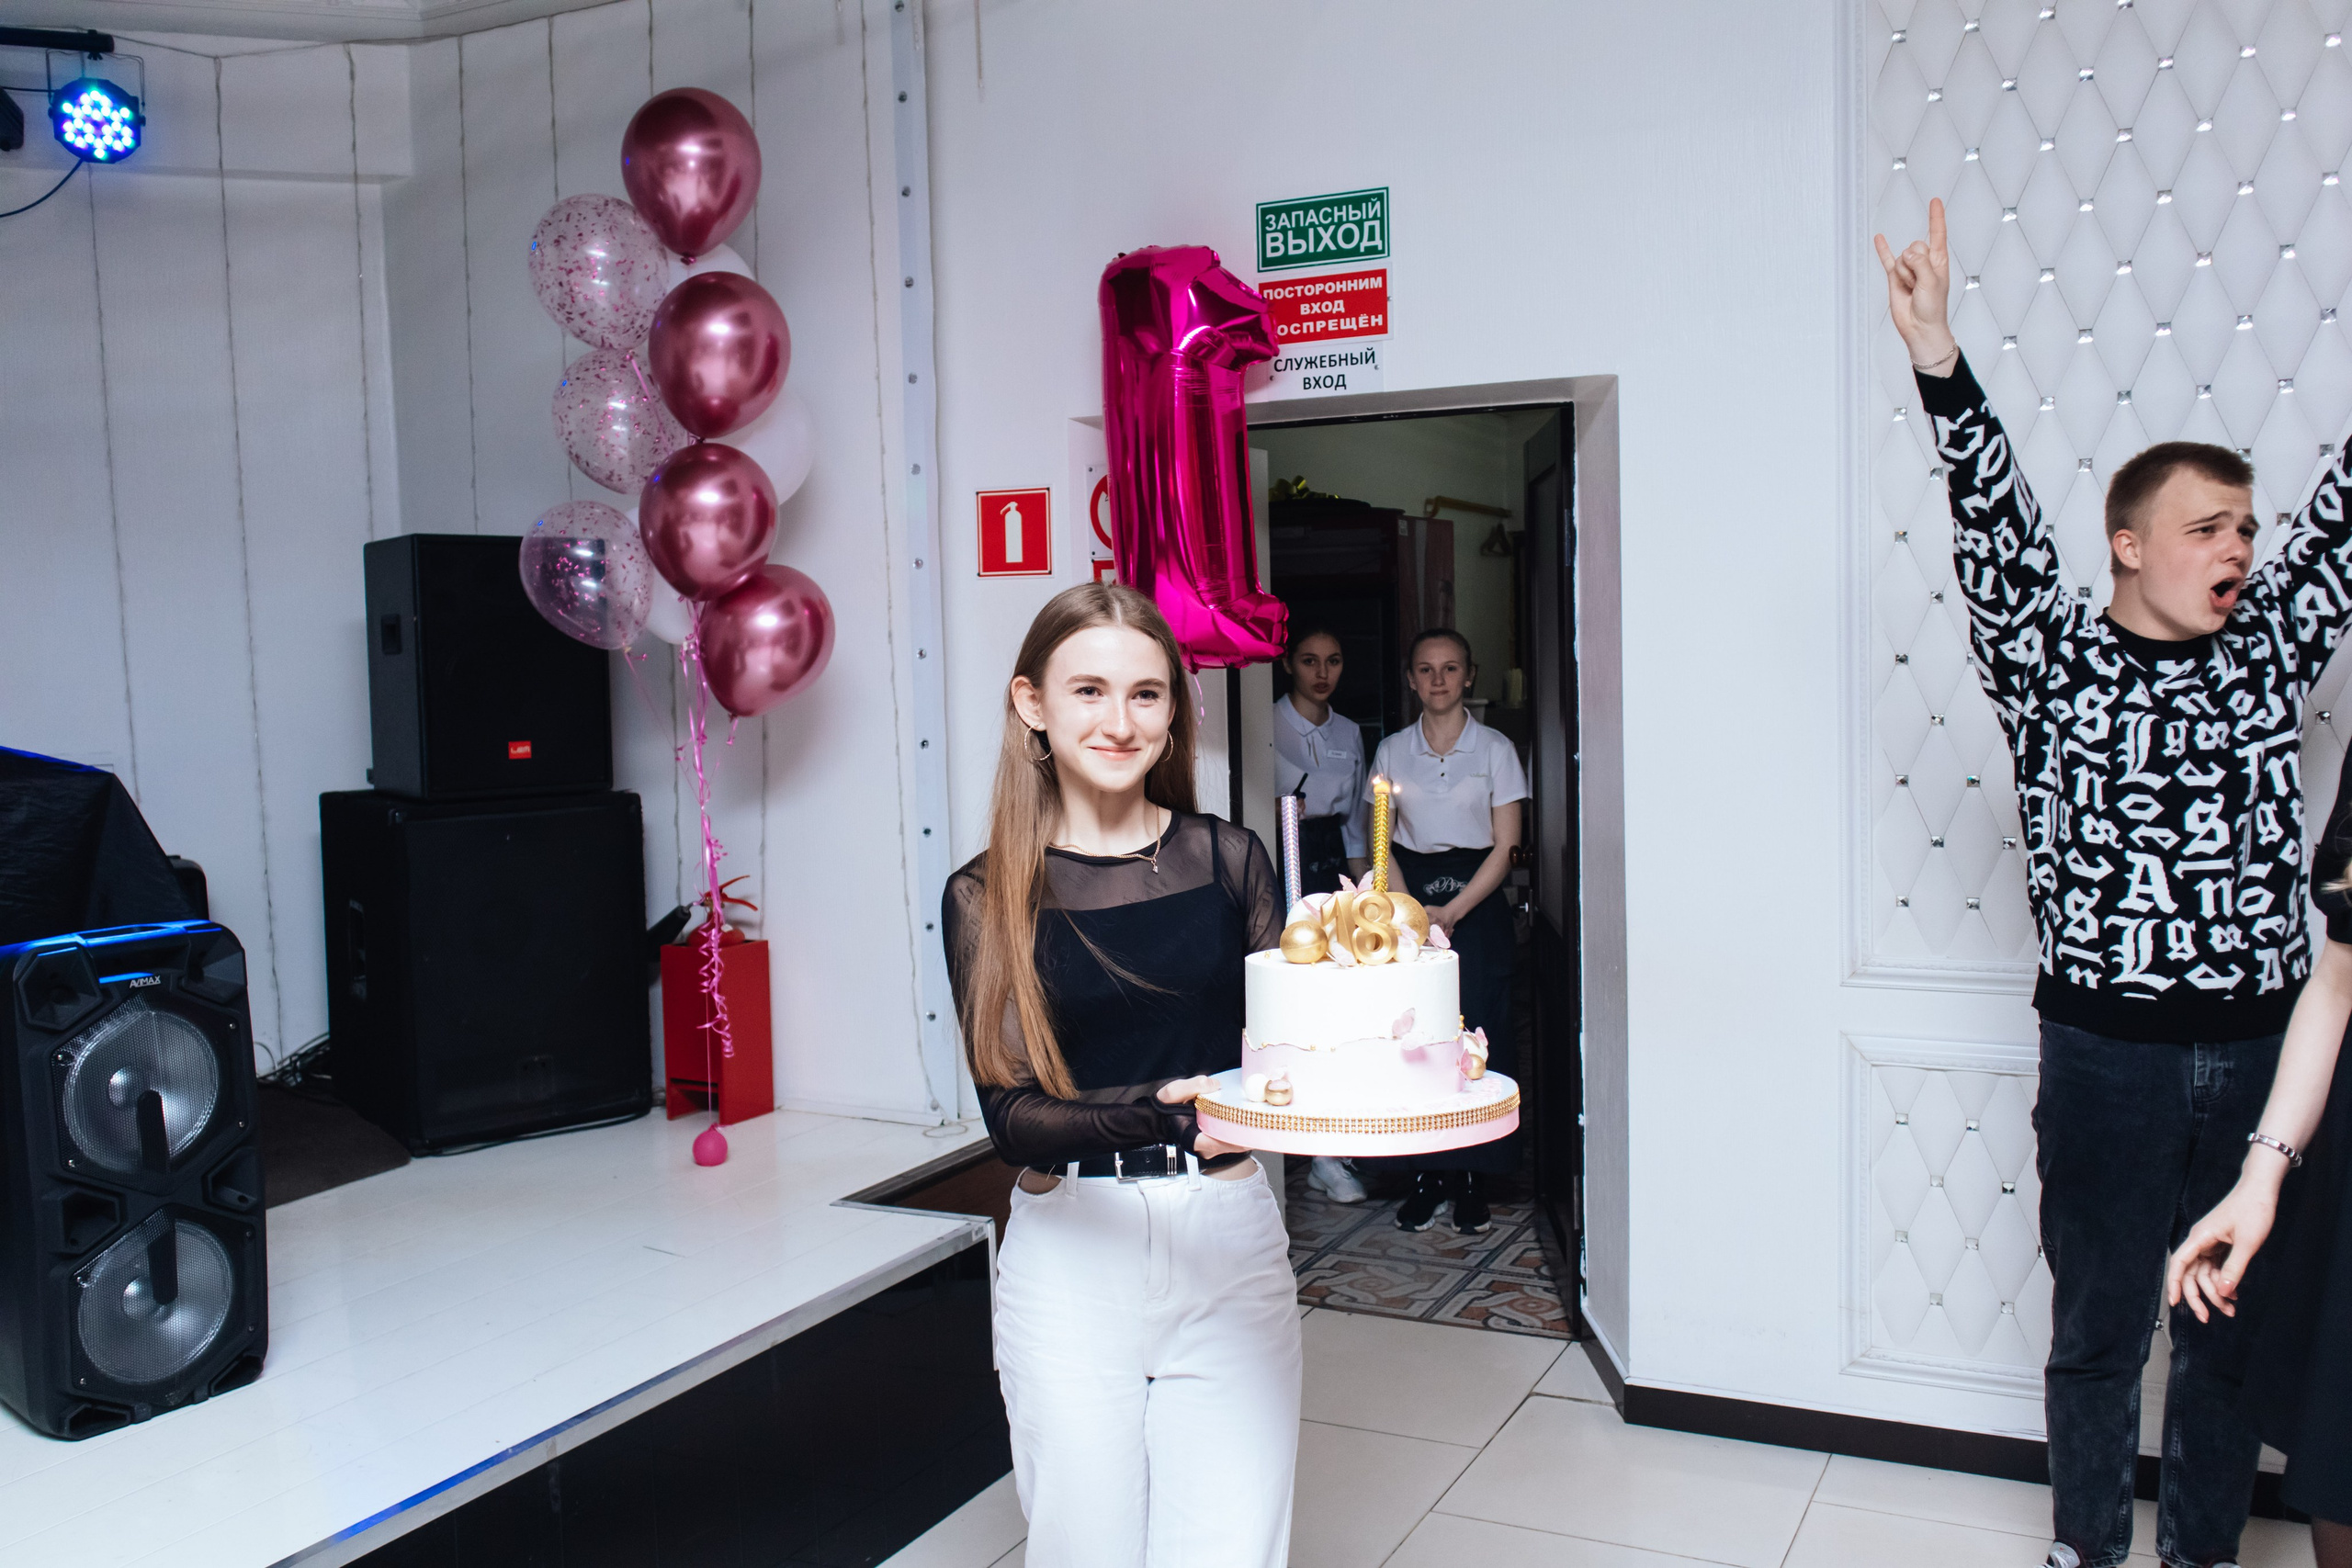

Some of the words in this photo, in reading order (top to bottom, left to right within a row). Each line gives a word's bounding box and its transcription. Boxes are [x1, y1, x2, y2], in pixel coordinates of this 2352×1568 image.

[1264, 197, 1382, 231] ЗАПАСНЫЙ
[1265, 220, 1383, 258] ВЫХОД
[1262, 276, 1383, 300] ПОСТОРОННИМ
[1300, 299, 1345, 316] ВХОД
[1276, 313, 1384, 336] ОСПРЕЩЁН
[1273, 346, 1376, 372] СЛУЖЕБНЫЙ
[1303, 374, 1347, 390] ВХОД
[1320, 889, 1398, 965] 18
